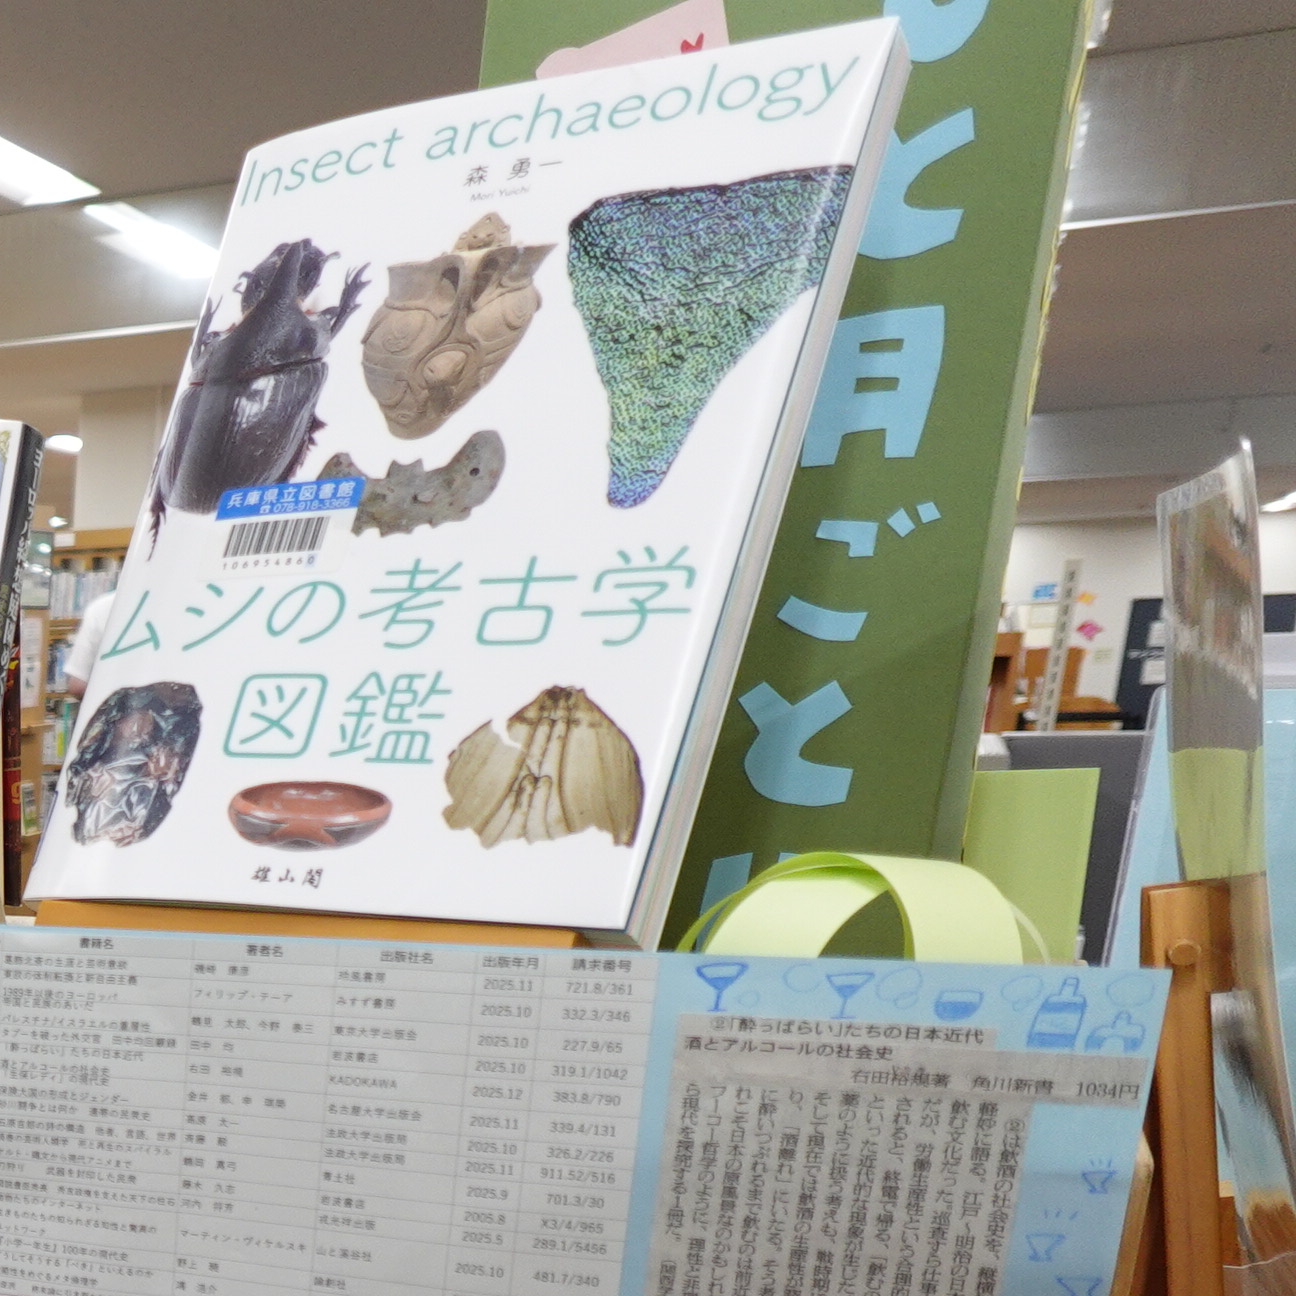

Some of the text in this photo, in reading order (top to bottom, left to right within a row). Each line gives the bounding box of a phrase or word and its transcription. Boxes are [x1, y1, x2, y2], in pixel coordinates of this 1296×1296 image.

[240, 58, 860, 208] Insect archaeology
[463, 157, 563, 187] 森 勇一
[226, 480, 357, 511] 兵庫県立図書館
[273, 497, 352, 515] 078-918-3366
[222, 553, 316, 573] 106954860
[100, 545, 698, 662] ムシの考古学
[223, 670, 455, 766] 図鑑
[251, 866, 324, 888] 雄山閣
[481, 956, 540, 970] 出版年月
[571, 957, 632, 973] 請求番号
[683, 1035, 894, 1062] 酒とアルコールの社会史
